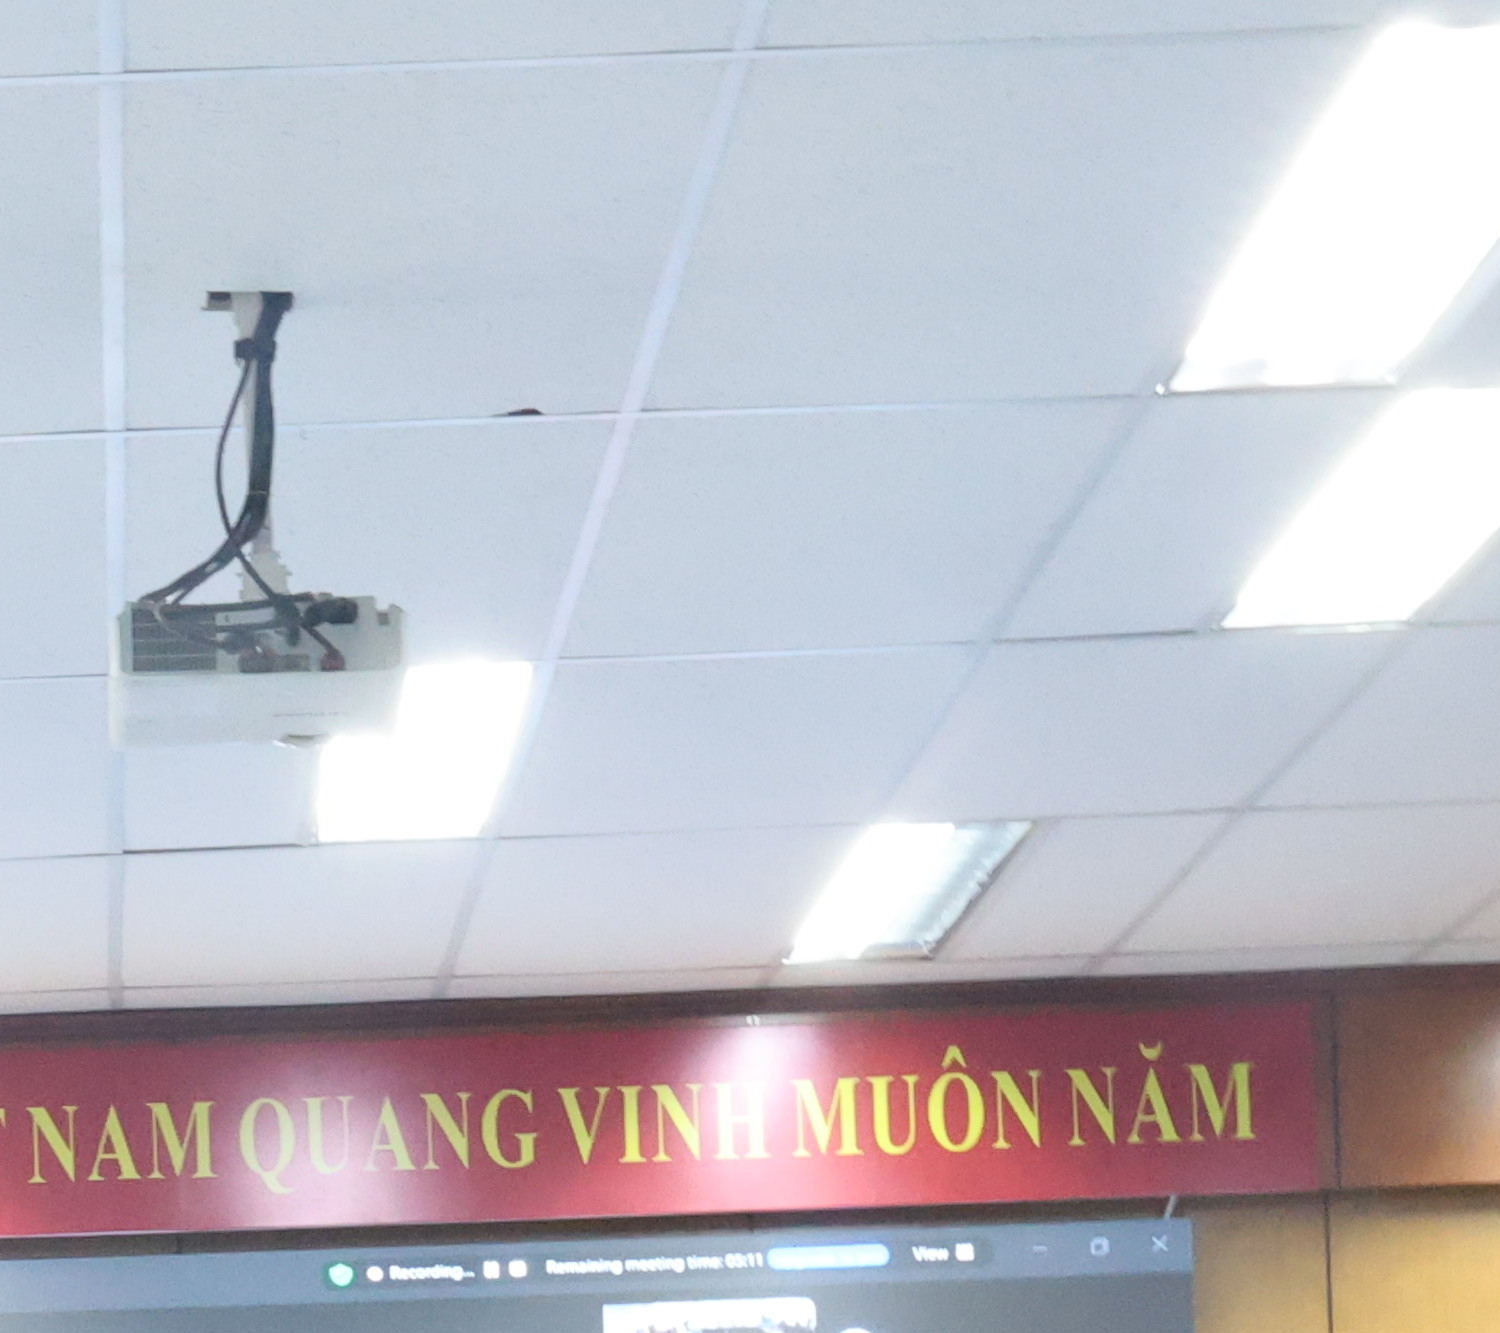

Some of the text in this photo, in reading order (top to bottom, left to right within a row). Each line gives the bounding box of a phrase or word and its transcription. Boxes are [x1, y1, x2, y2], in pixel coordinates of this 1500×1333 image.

[25, 1100, 218, 1184] NAM
[238, 1089, 539, 1195] QUANG
[557, 1080, 772, 1166] VINH
[791, 1045, 1043, 1157] MUÔN
[1065, 1041, 1257, 1149] NĂM
[545, 1259, 623, 1276] Remaining
[624, 1256, 686, 1273] meeting
[912, 1245, 950, 1262] View
